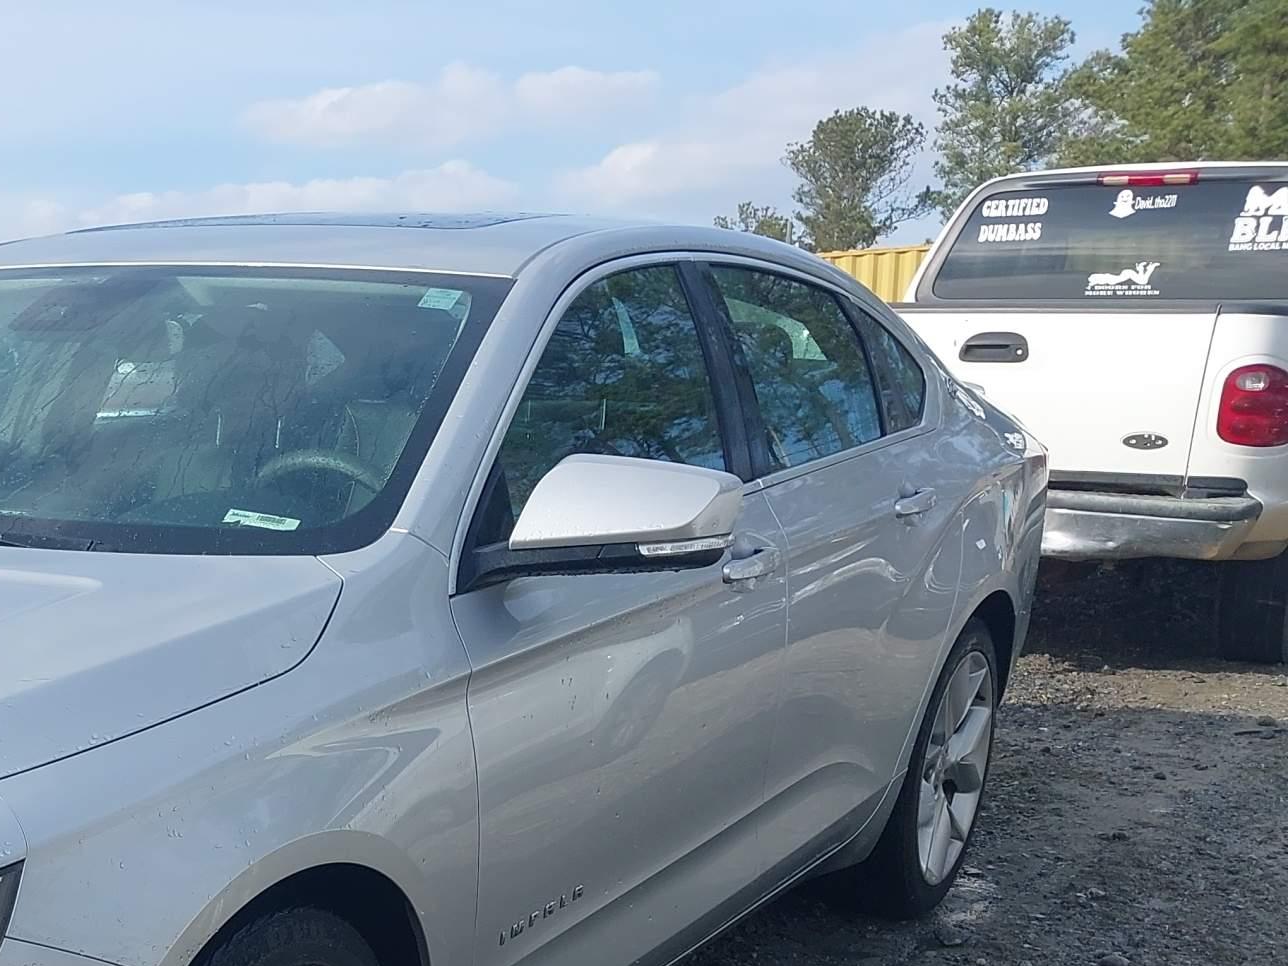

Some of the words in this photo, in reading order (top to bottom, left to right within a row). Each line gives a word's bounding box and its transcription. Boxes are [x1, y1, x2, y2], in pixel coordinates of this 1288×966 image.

[982, 198, 1049, 217] CERTIFIED
[978, 222, 1042, 243] DUMBASS
[1228, 243, 1252, 252] BANG
[1253, 242, 1281, 251] LOCAL
[499, 884, 584, 946] IMPALA
